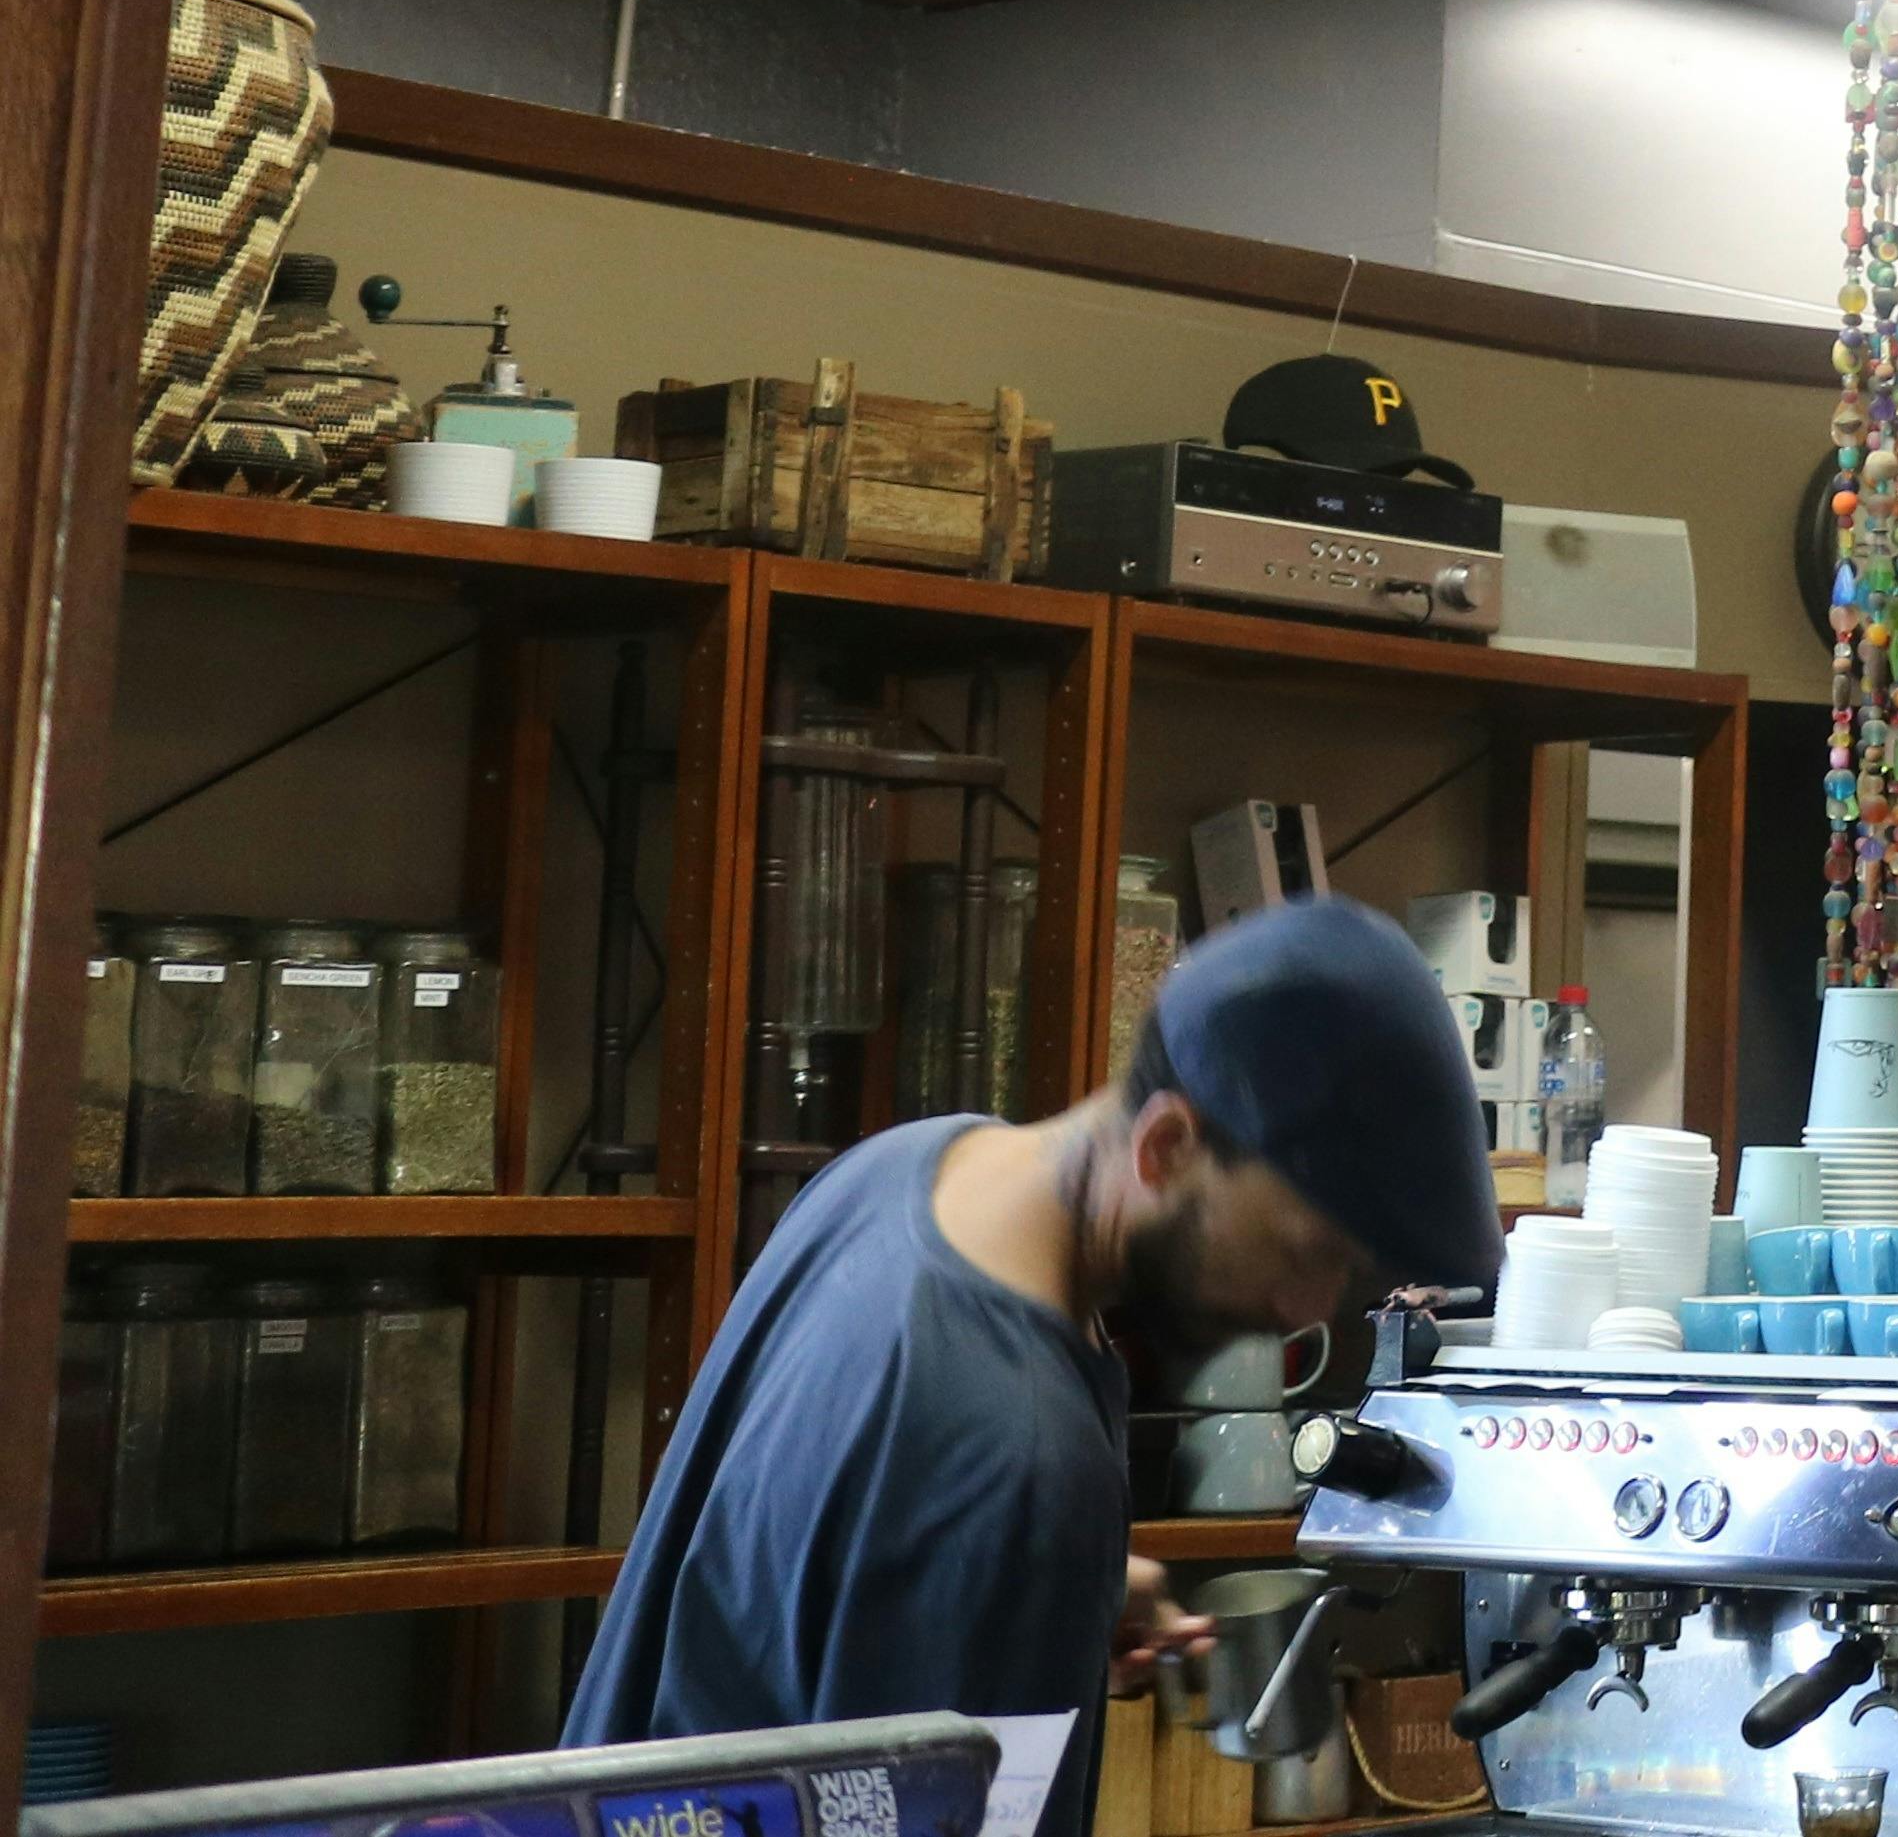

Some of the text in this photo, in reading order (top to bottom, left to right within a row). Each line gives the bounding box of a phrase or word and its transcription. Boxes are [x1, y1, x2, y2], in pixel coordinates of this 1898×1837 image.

[1364, 376, 1402, 427] P
[809, 1766, 890, 1797] WIDE
[613, 1798, 724, 1837] wide
[816, 1792, 898, 1824] OPEN
